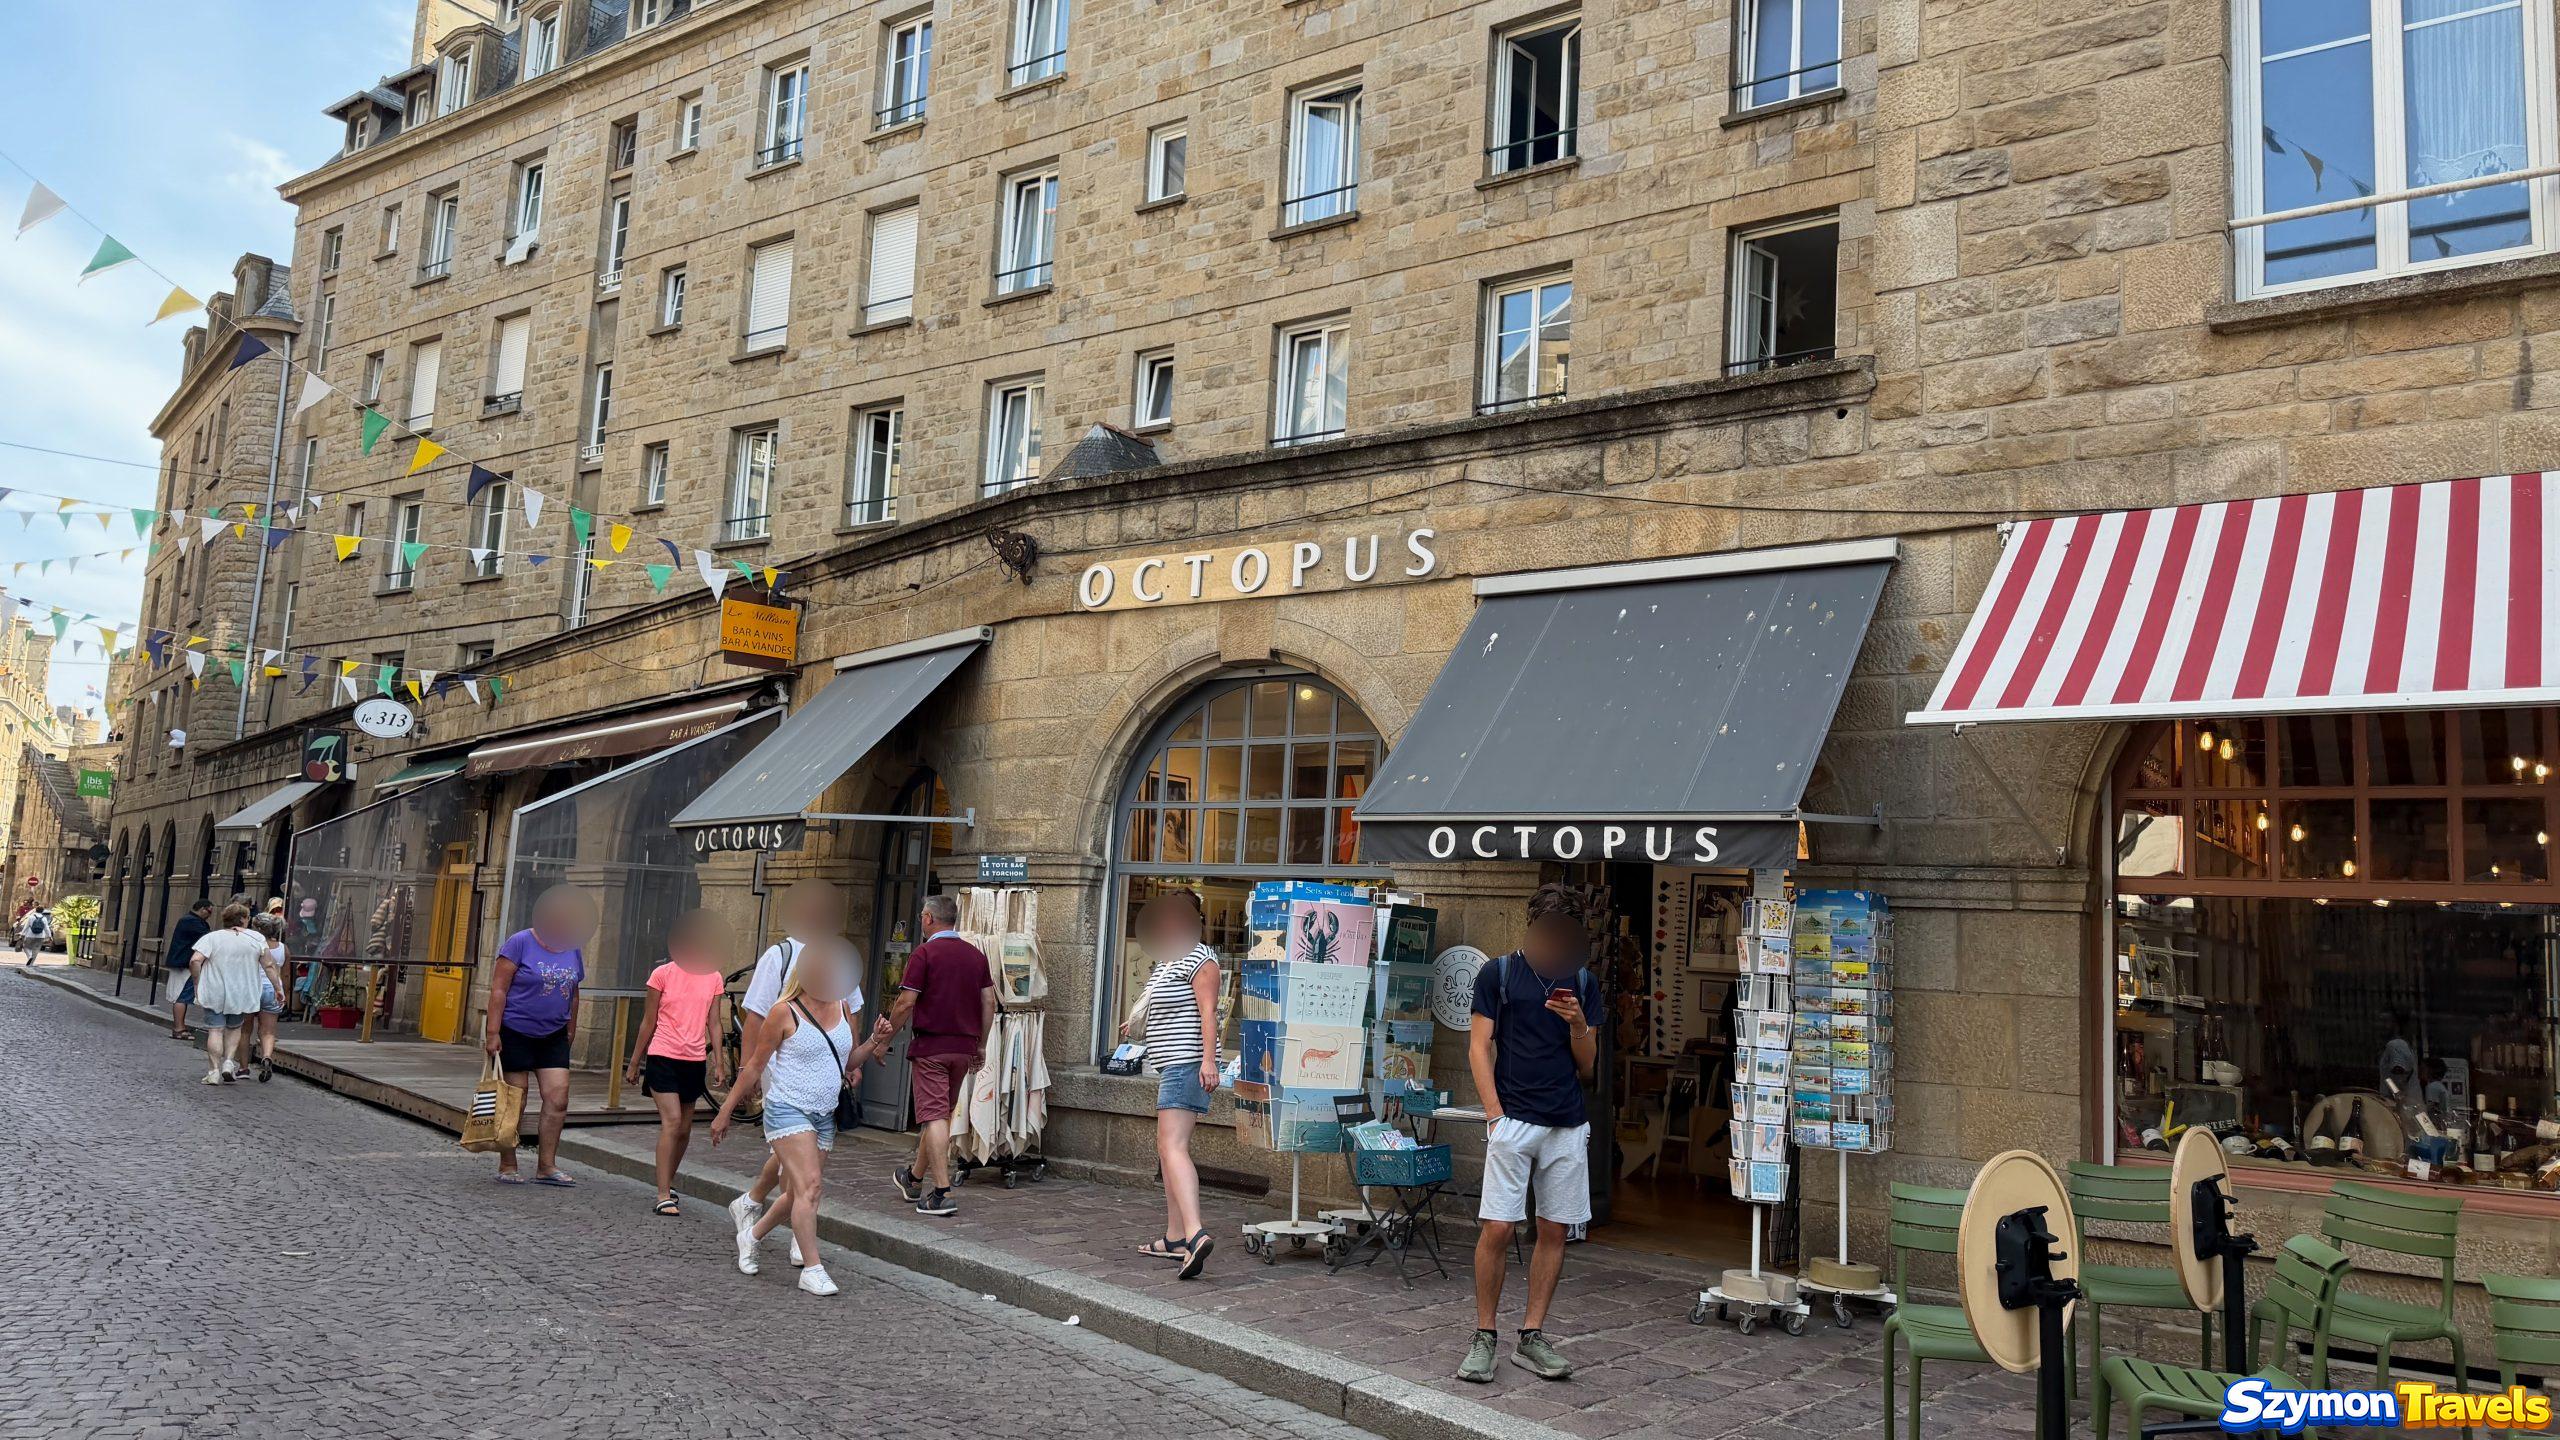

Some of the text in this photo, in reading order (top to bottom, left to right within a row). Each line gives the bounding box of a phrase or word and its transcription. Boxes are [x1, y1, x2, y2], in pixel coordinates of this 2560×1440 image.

[1079, 528, 1436, 608] OCTOPUS
[733, 625, 752, 636] BAR
[762, 630, 784, 642] VINS
[721, 636, 741, 647] BAR
[752, 641, 792, 655] VIANDES
[361, 711, 408, 728] le 313
[87, 775, 102, 785] ibis
[695, 824, 783, 852] OCTOPUS
[1428, 825, 1719, 863] OCTOPUS
[1305, 886, 1321, 895] Sets
